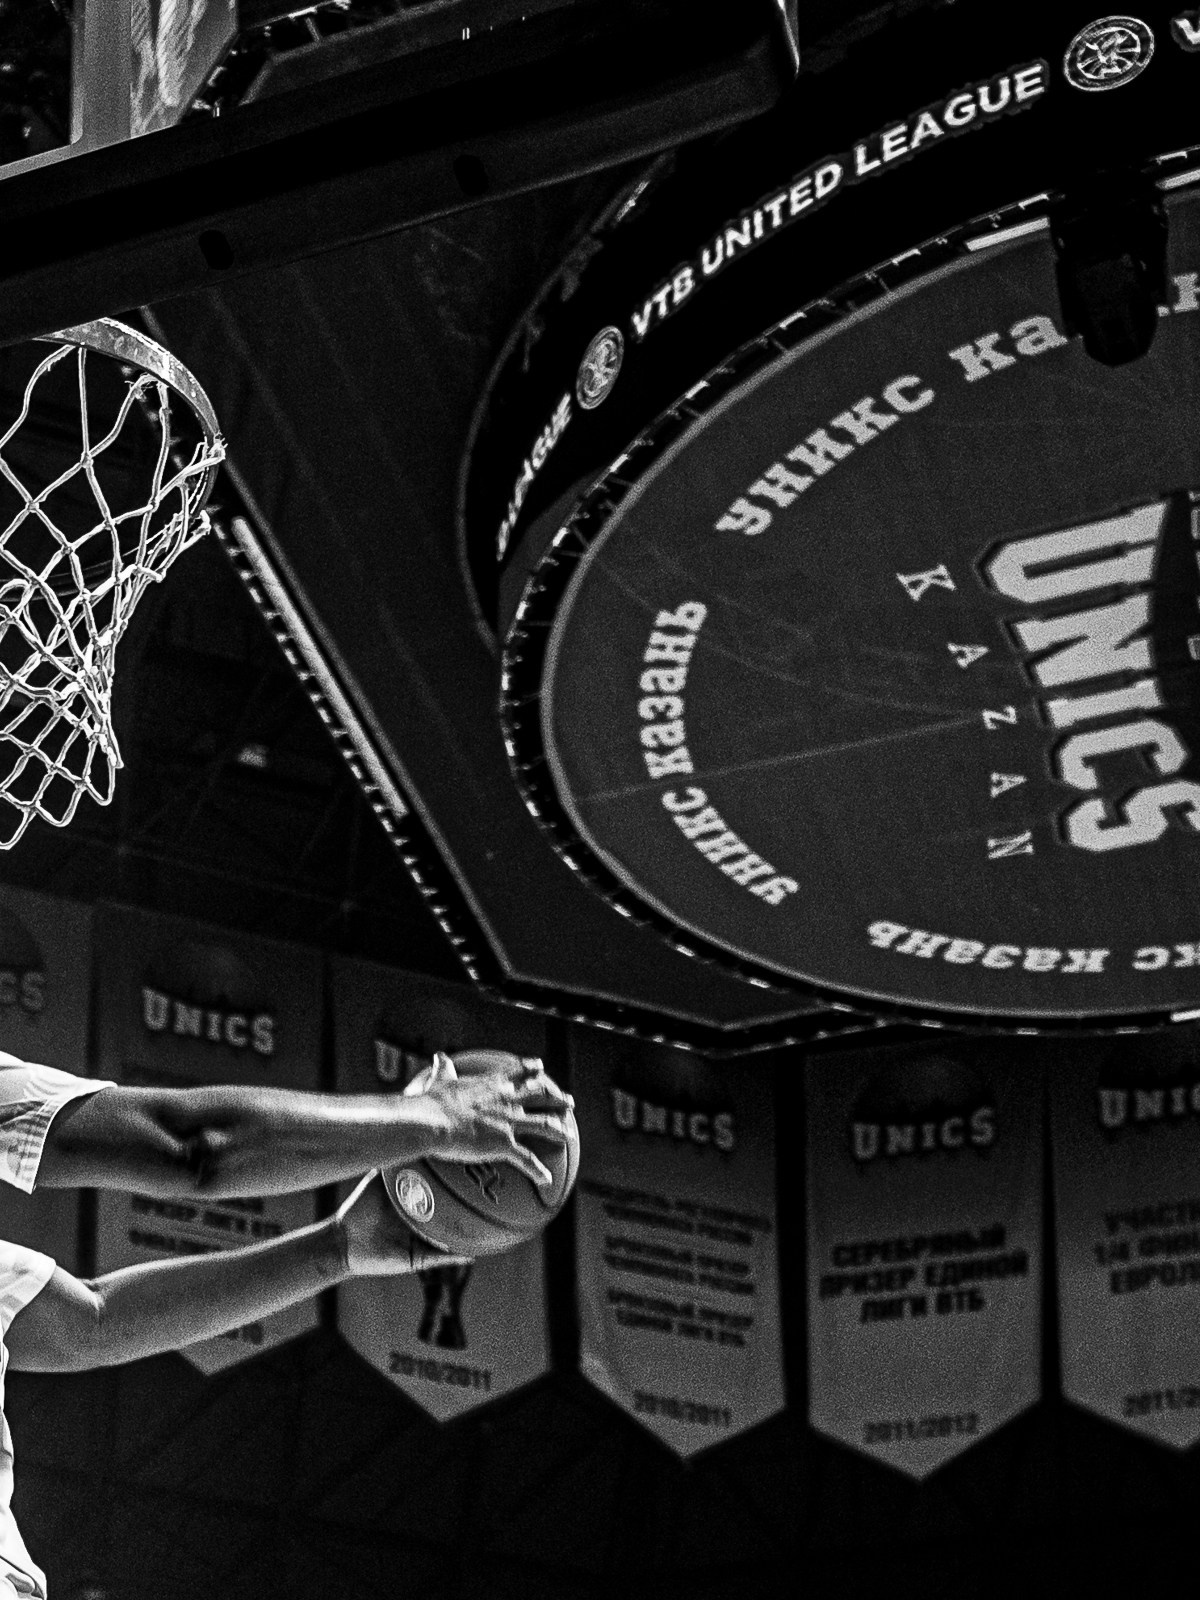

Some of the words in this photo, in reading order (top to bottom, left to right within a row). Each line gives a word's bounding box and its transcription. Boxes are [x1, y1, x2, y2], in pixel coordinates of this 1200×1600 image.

[631, 266, 695, 337] VTB
[701, 163, 844, 275] UNITED
[853, 63, 1046, 177] LEAGUE
[714, 374, 936, 536] УНИКС
[638, 600, 708, 779] Казань
[987, 500, 1200, 853] UNICS
[661, 785, 800, 906] УНИКС
[141, 985, 277, 1056] UNICS
[611, 1088, 737, 1152] UNICS
[853, 1104, 997, 1162] UNICS
[864, 1412, 979, 1444] 2011/2012
